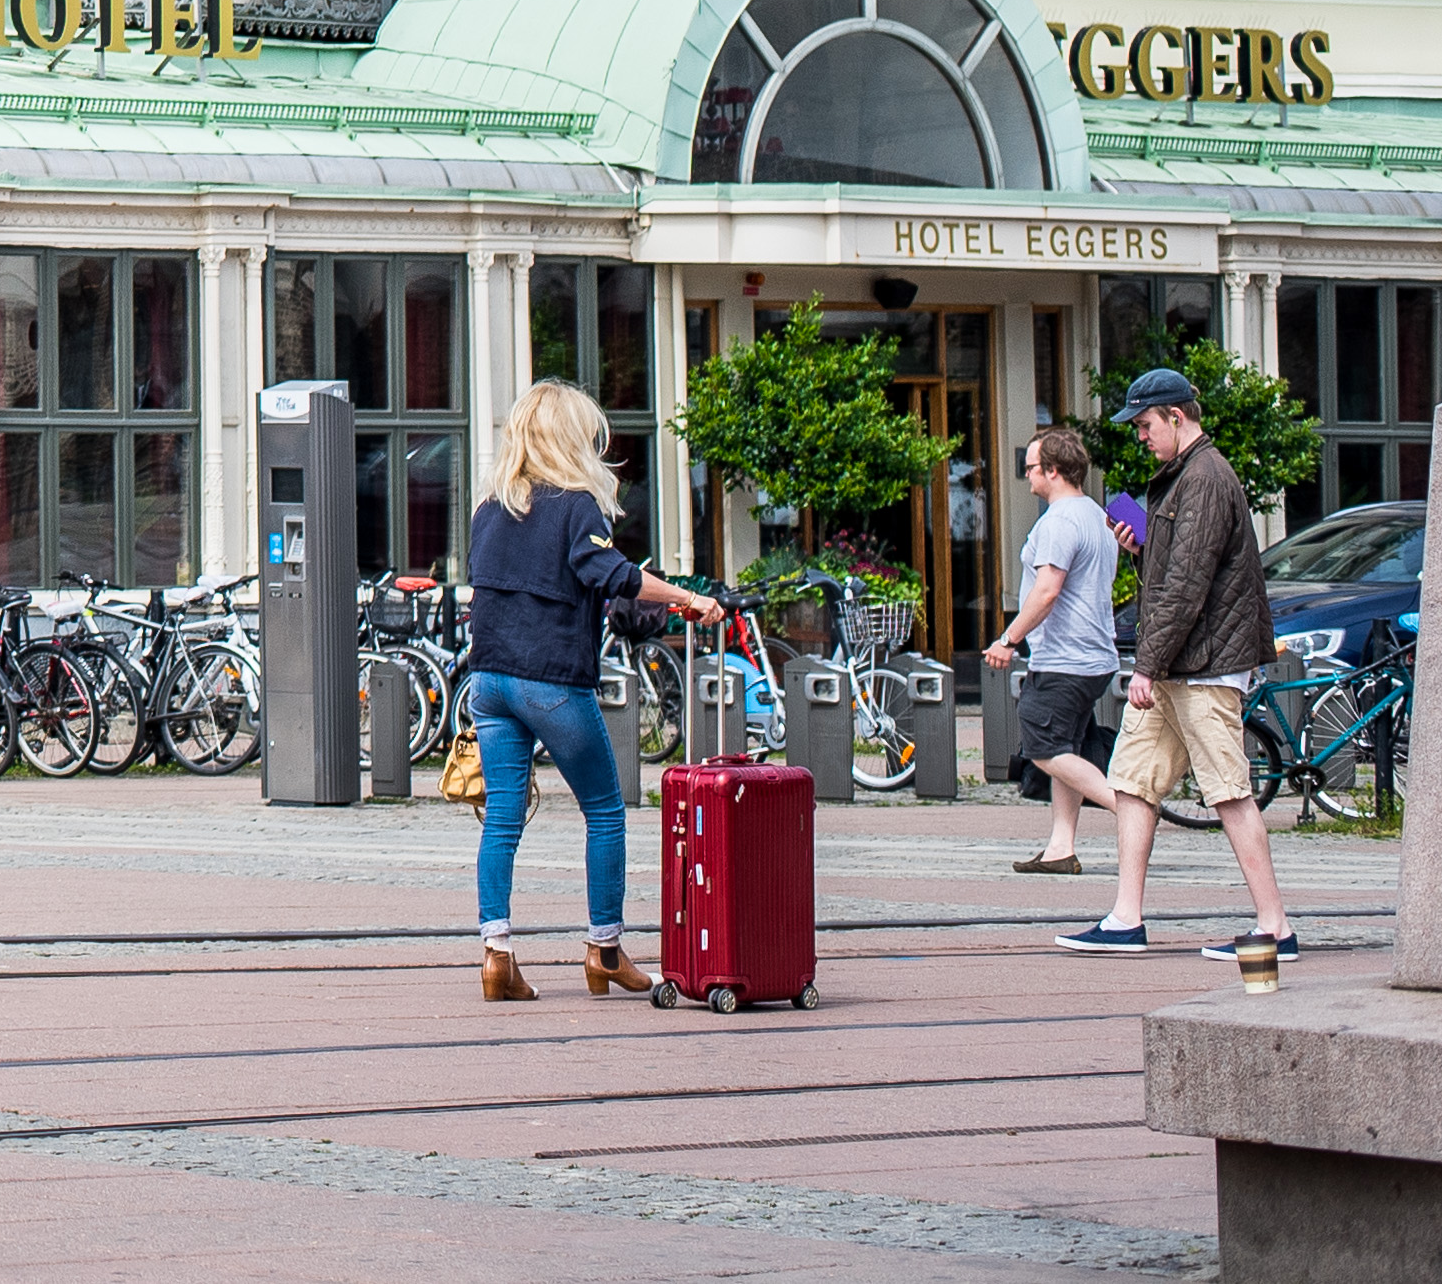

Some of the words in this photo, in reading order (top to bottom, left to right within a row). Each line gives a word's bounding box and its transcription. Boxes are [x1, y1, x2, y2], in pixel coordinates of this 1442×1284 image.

[1046, 21, 1334, 106] GGERS
[894, 220, 1005, 256] HOTEL
[1026, 225, 1169, 261] EGGERS
